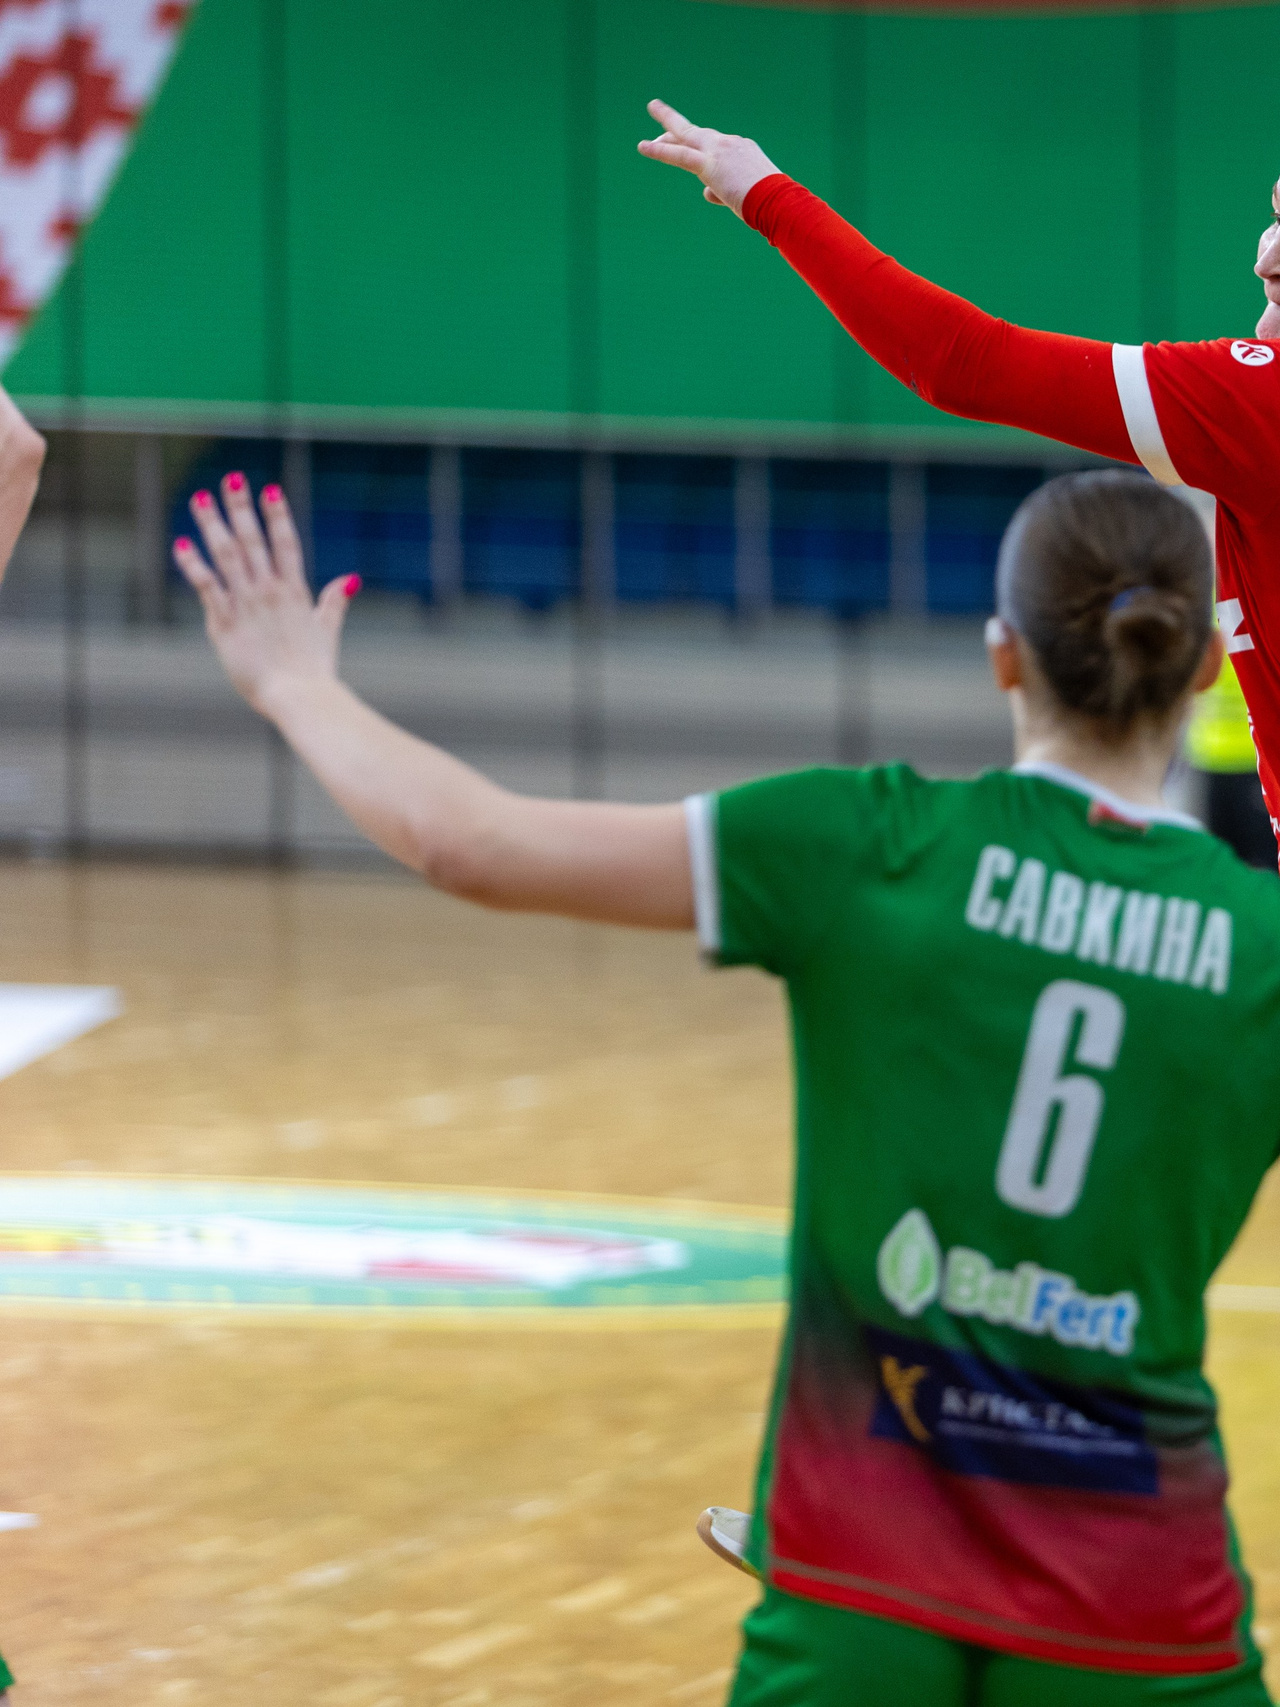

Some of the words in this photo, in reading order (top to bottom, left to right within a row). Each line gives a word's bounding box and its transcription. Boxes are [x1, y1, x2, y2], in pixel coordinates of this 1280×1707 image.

[965, 844, 1233, 995] САВКИНА
[995, 978, 1126, 1219] 6
[942, 1246, 1140, 1356] BelFert
